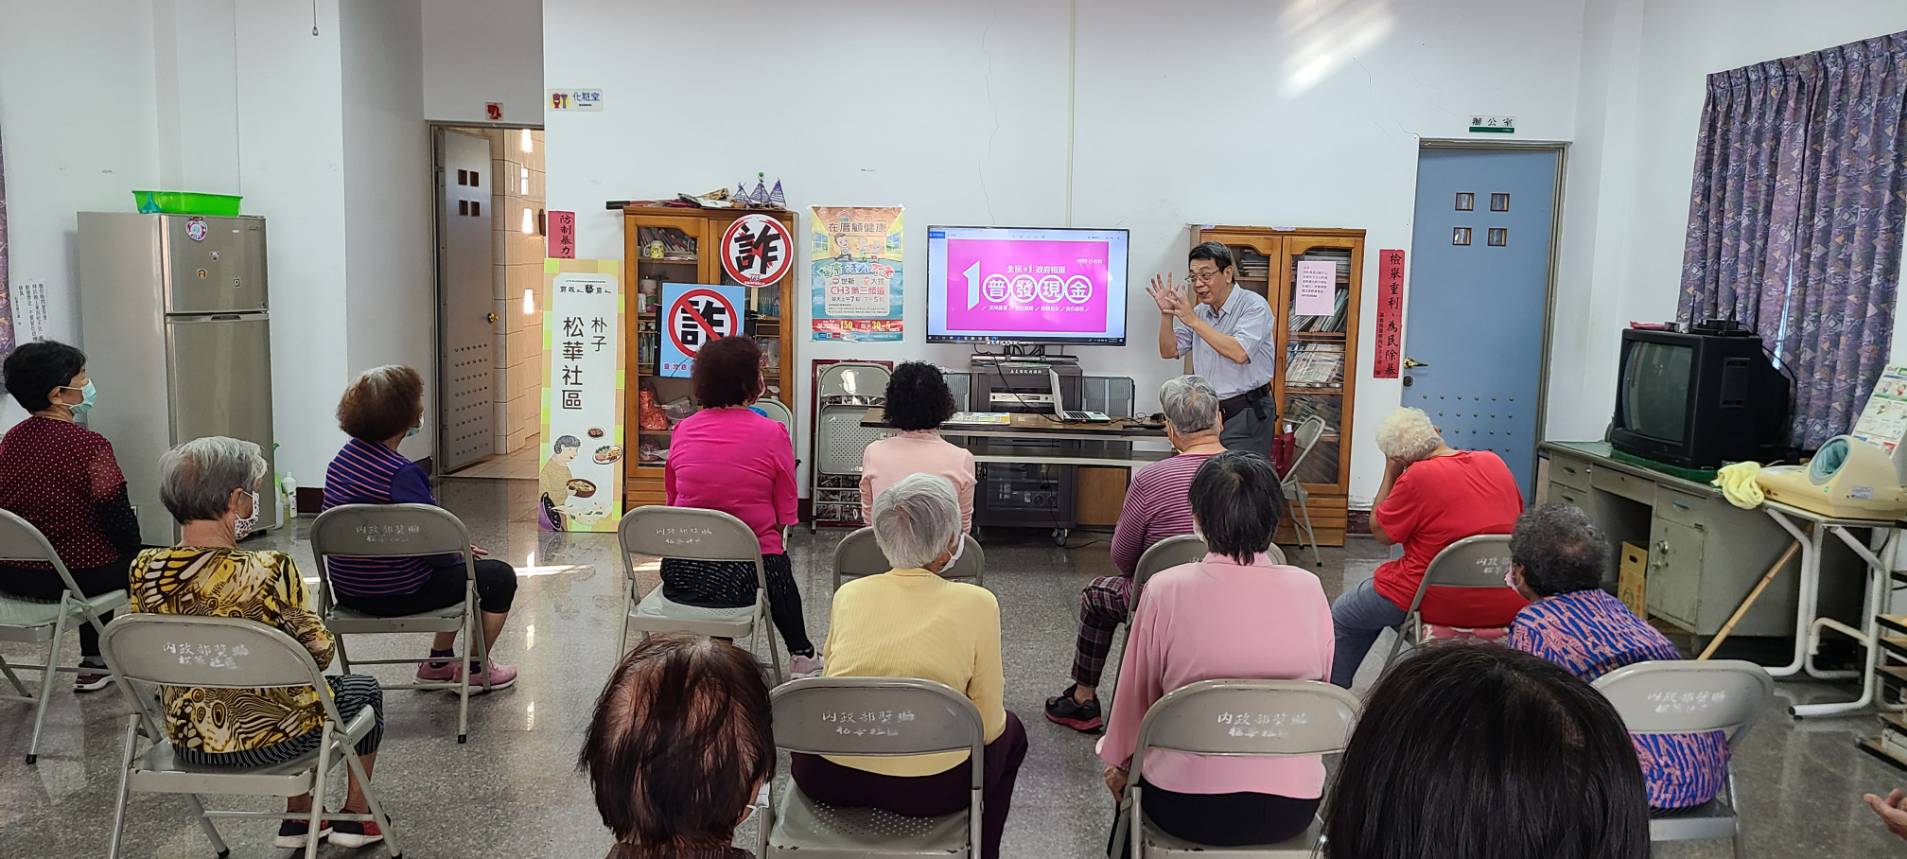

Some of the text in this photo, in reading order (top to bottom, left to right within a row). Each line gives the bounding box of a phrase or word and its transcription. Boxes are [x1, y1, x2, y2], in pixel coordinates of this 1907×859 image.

[734, 224, 781, 275] 詐
[590, 316, 608, 352] 朴子
[561, 316, 584, 410] 松華社區
